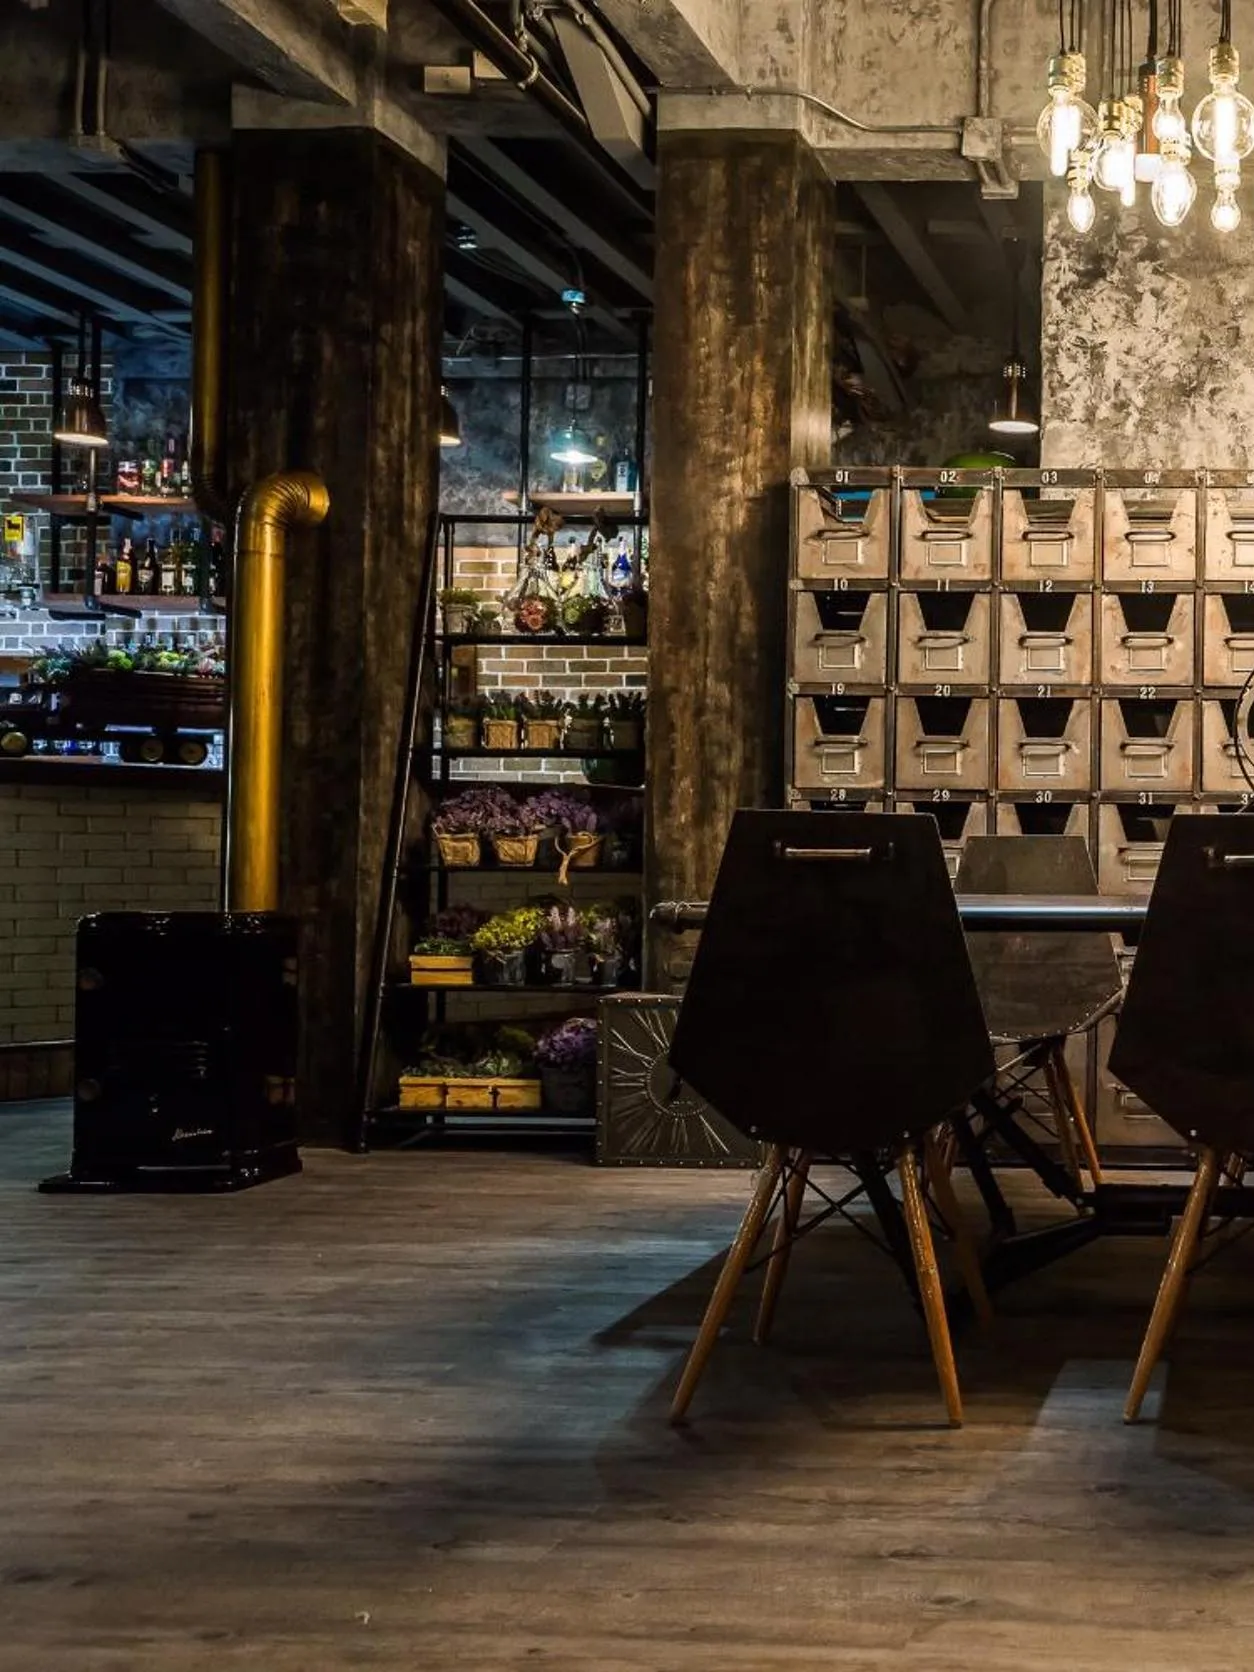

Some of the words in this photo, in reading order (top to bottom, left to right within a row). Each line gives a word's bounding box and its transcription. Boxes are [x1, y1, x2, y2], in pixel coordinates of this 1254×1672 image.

[835, 471, 849, 483] 01
[940, 471, 957, 483] 02
[1041, 471, 1058, 483] 03
[833, 579, 848, 591] 10
[936, 579, 950, 591] 11
[1038, 579, 1053, 592] 12
[1141, 580, 1154, 592] 13
[830, 684, 845, 696] 19
[935, 685, 951, 697] 20
[1037, 686, 1052, 698] 21
[1139, 687, 1157, 699] 22
[830, 789, 847, 801] 28
[933, 789, 950, 801] 29
[1035, 790, 1052, 803] 30
[1139, 792, 1154, 804] 31
